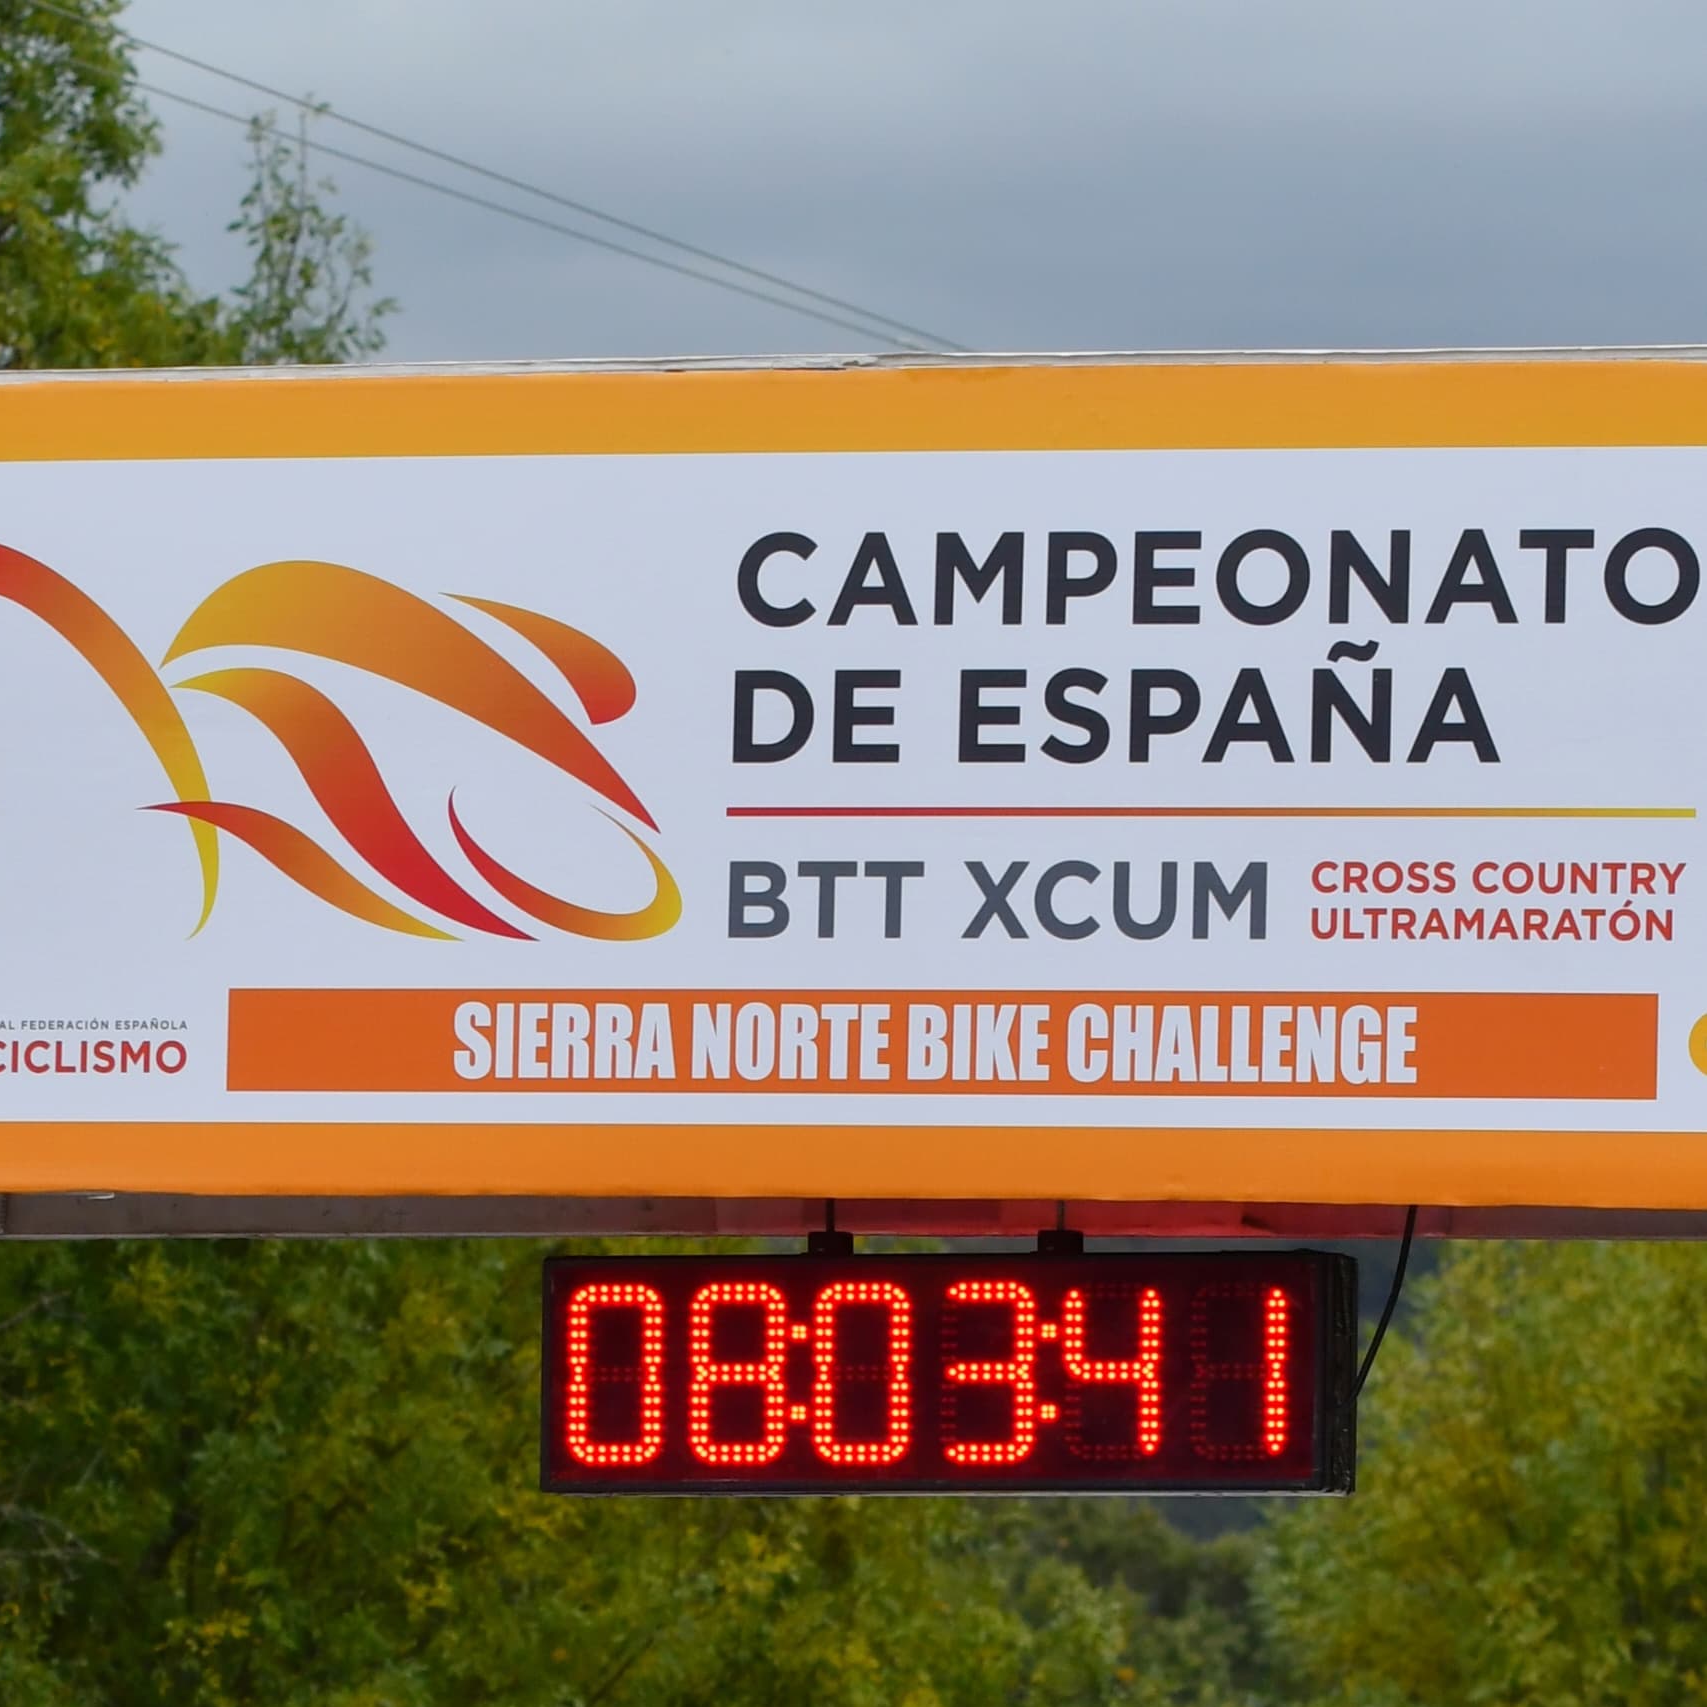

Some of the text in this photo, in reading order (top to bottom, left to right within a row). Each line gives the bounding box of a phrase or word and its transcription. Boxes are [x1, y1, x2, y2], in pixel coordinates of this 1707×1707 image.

[737, 528, 1700, 627] CAMPEONATO
[732, 640, 1500, 764] DE ESPAÑA
[727, 860, 1267, 939] BTT XCUM
[1311, 861, 1687, 895] CROSS COUNTRY
[1311, 900, 1673, 942] ULTRAMARATÓN
[21, 1018, 109, 1031] FEDERACIÓN
[115, 1018, 188, 1031] ESPAÑOLA
[454, 1001, 1418, 1085] SIERRA NORTE BIKE CHALLENGE
[567, 1282, 1287, 1464] 08:03:41
